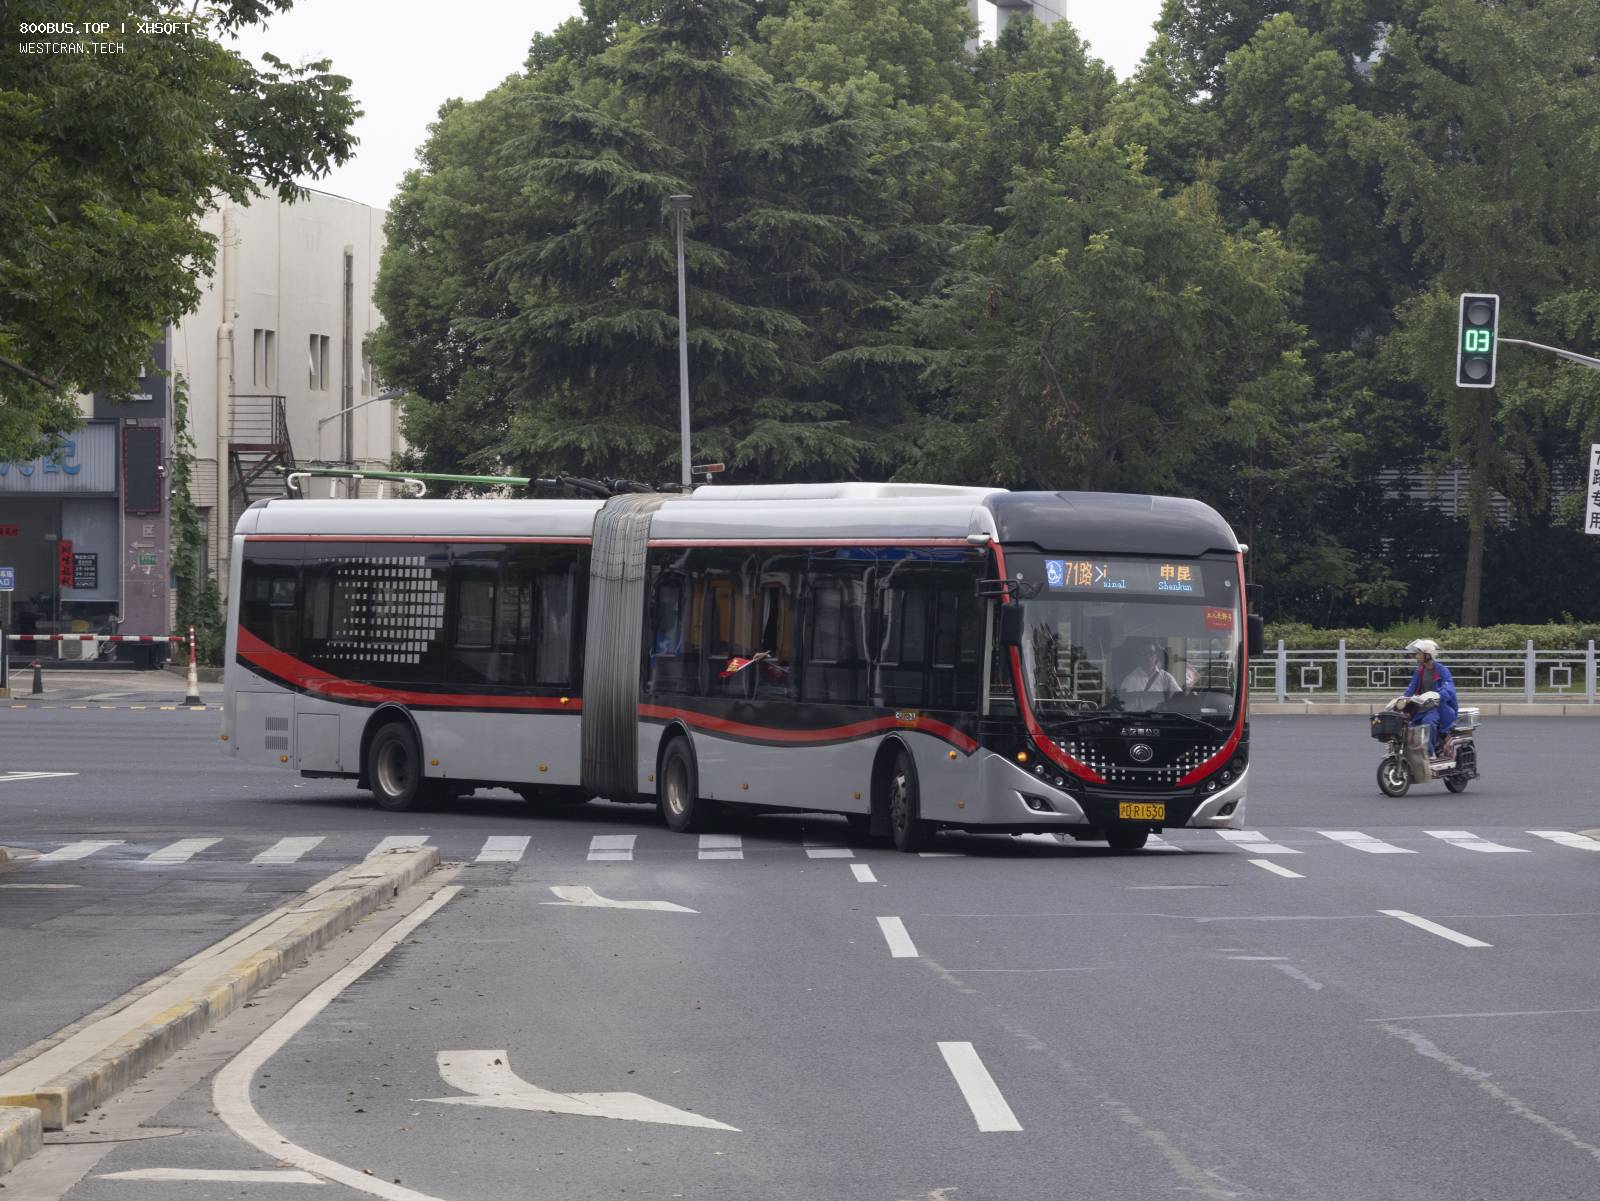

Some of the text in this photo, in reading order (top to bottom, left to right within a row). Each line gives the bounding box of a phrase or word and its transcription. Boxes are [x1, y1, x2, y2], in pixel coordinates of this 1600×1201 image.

[1465, 329, 1490, 352] 03
[1160, 563, 1192, 581] 申昆
[1158, 581, 1193, 591] Shenkun
